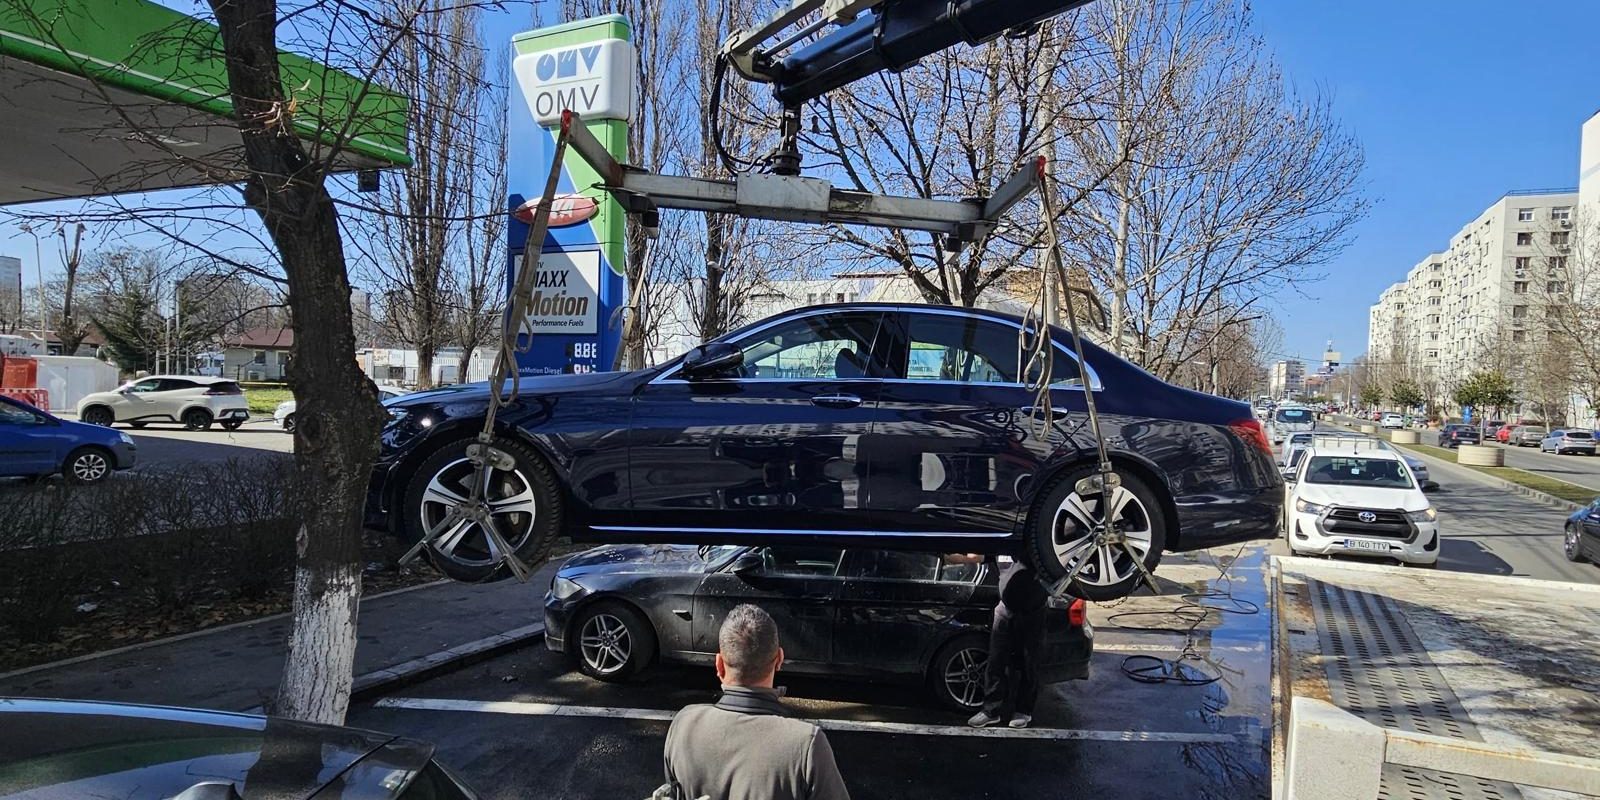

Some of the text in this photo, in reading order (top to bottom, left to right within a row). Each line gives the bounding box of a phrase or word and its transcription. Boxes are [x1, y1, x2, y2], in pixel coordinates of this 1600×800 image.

[536, 44, 602, 82] OMV
[536, 84, 600, 117] OMV
[527, 290, 589, 316] Motion
[532, 319, 585, 327] Performance Fuels
[544, 366, 562, 375] Diesel
[1358, 541, 1370, 549] 140
